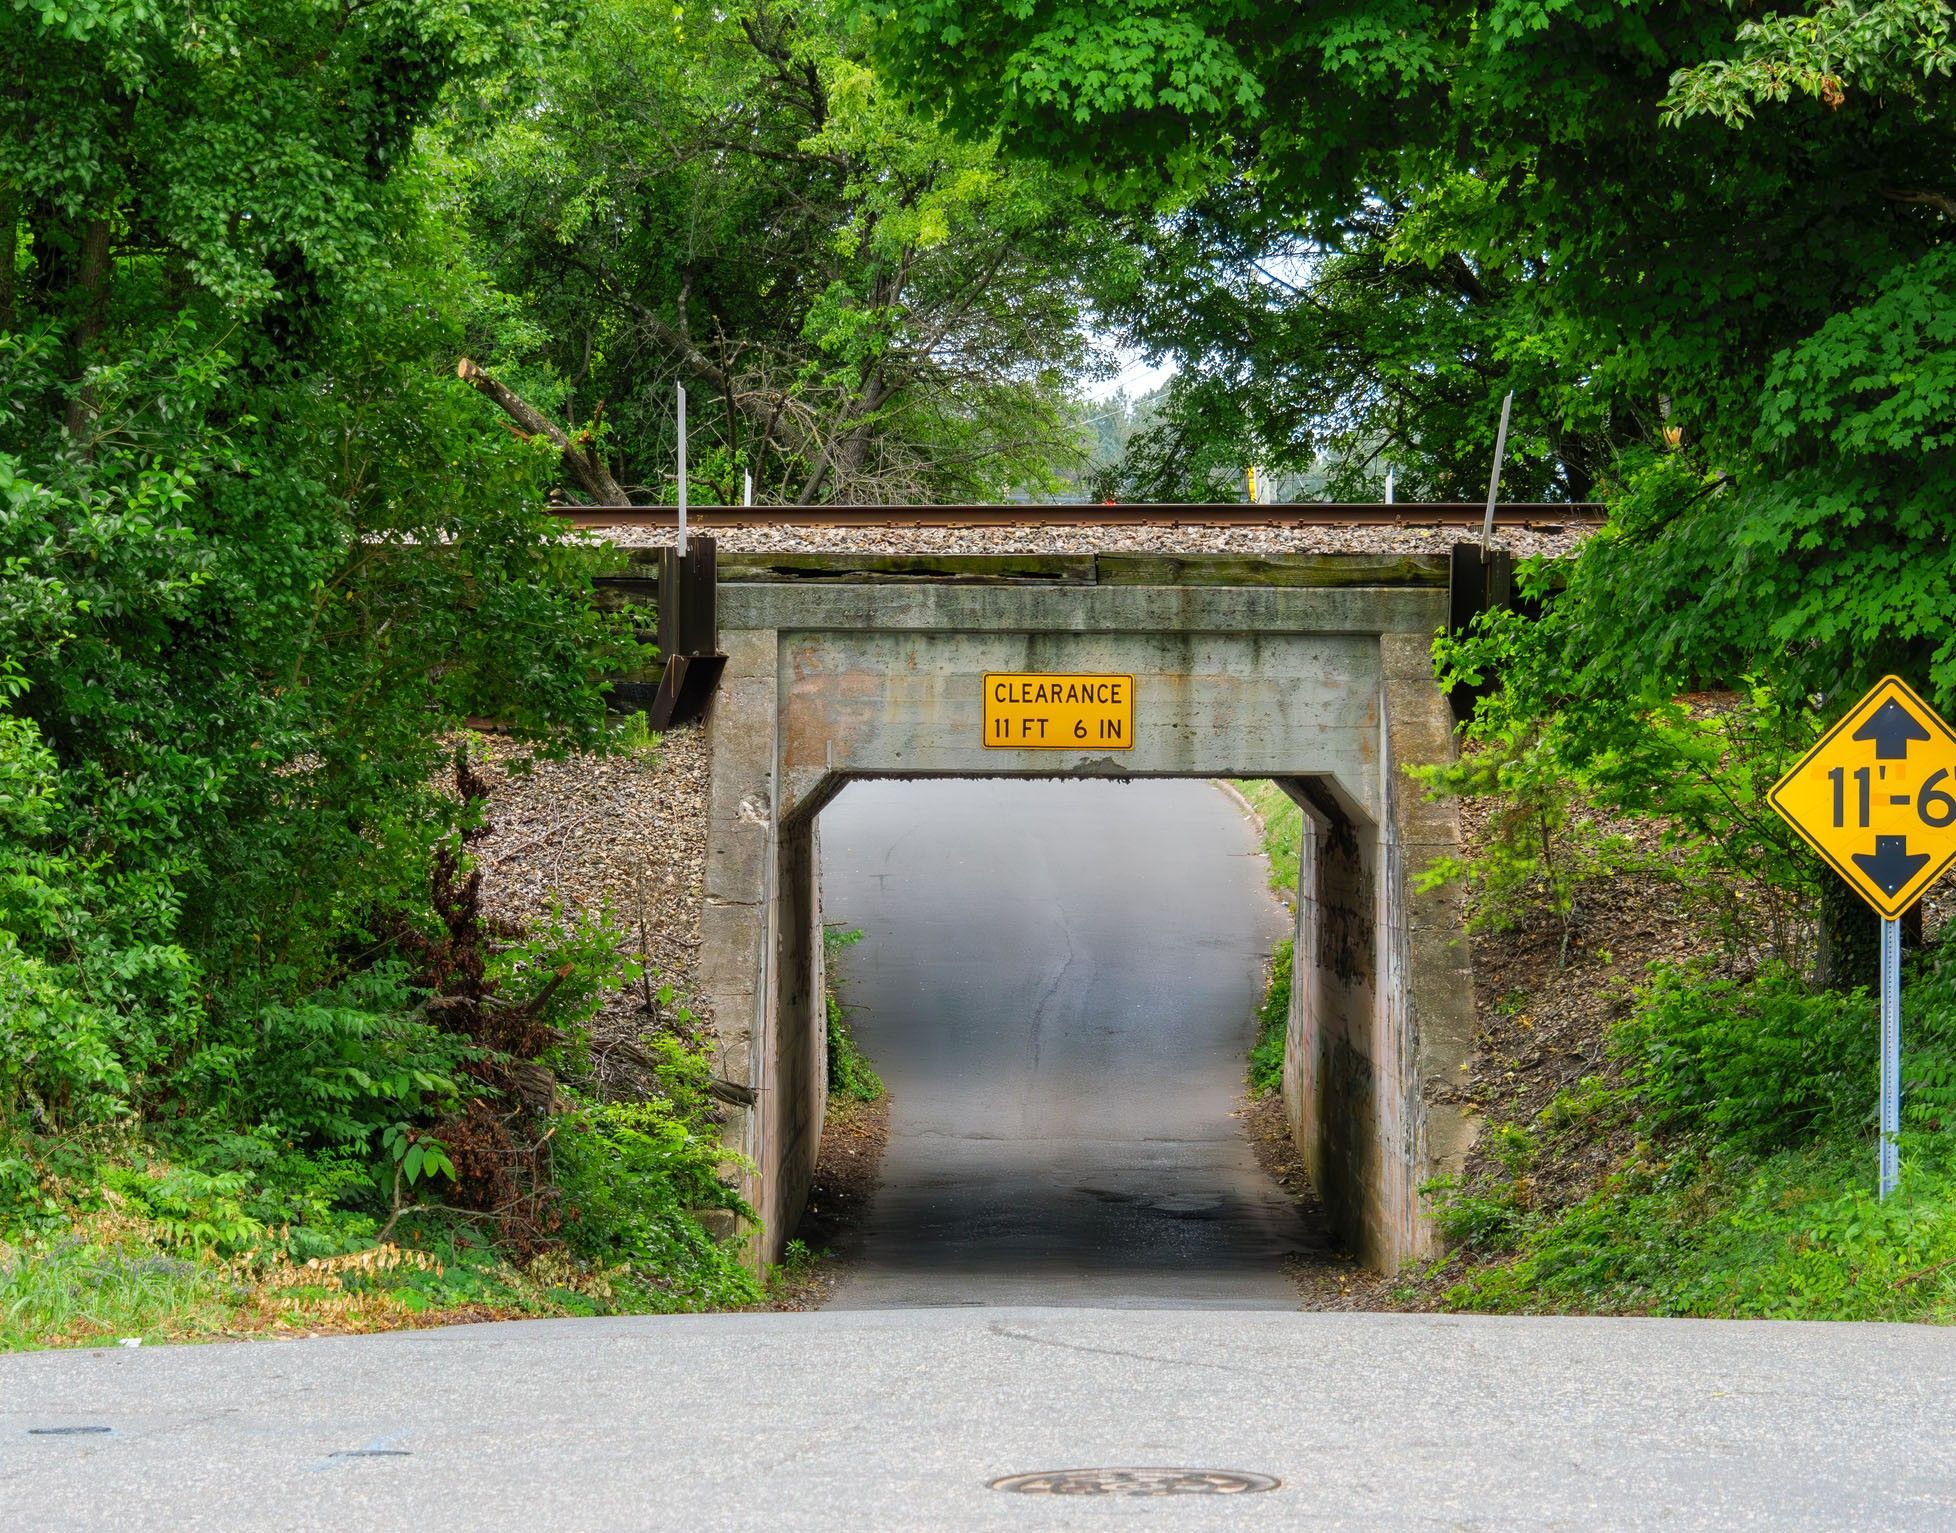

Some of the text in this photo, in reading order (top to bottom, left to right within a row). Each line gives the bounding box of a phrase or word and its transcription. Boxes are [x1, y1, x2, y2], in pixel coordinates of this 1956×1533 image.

[995, 683, 1122, 704] CLEARANCE
[994, 718, 1122, 739] 11 FT 6 IN
[1828, 765, 1956, 828] 11'-6
